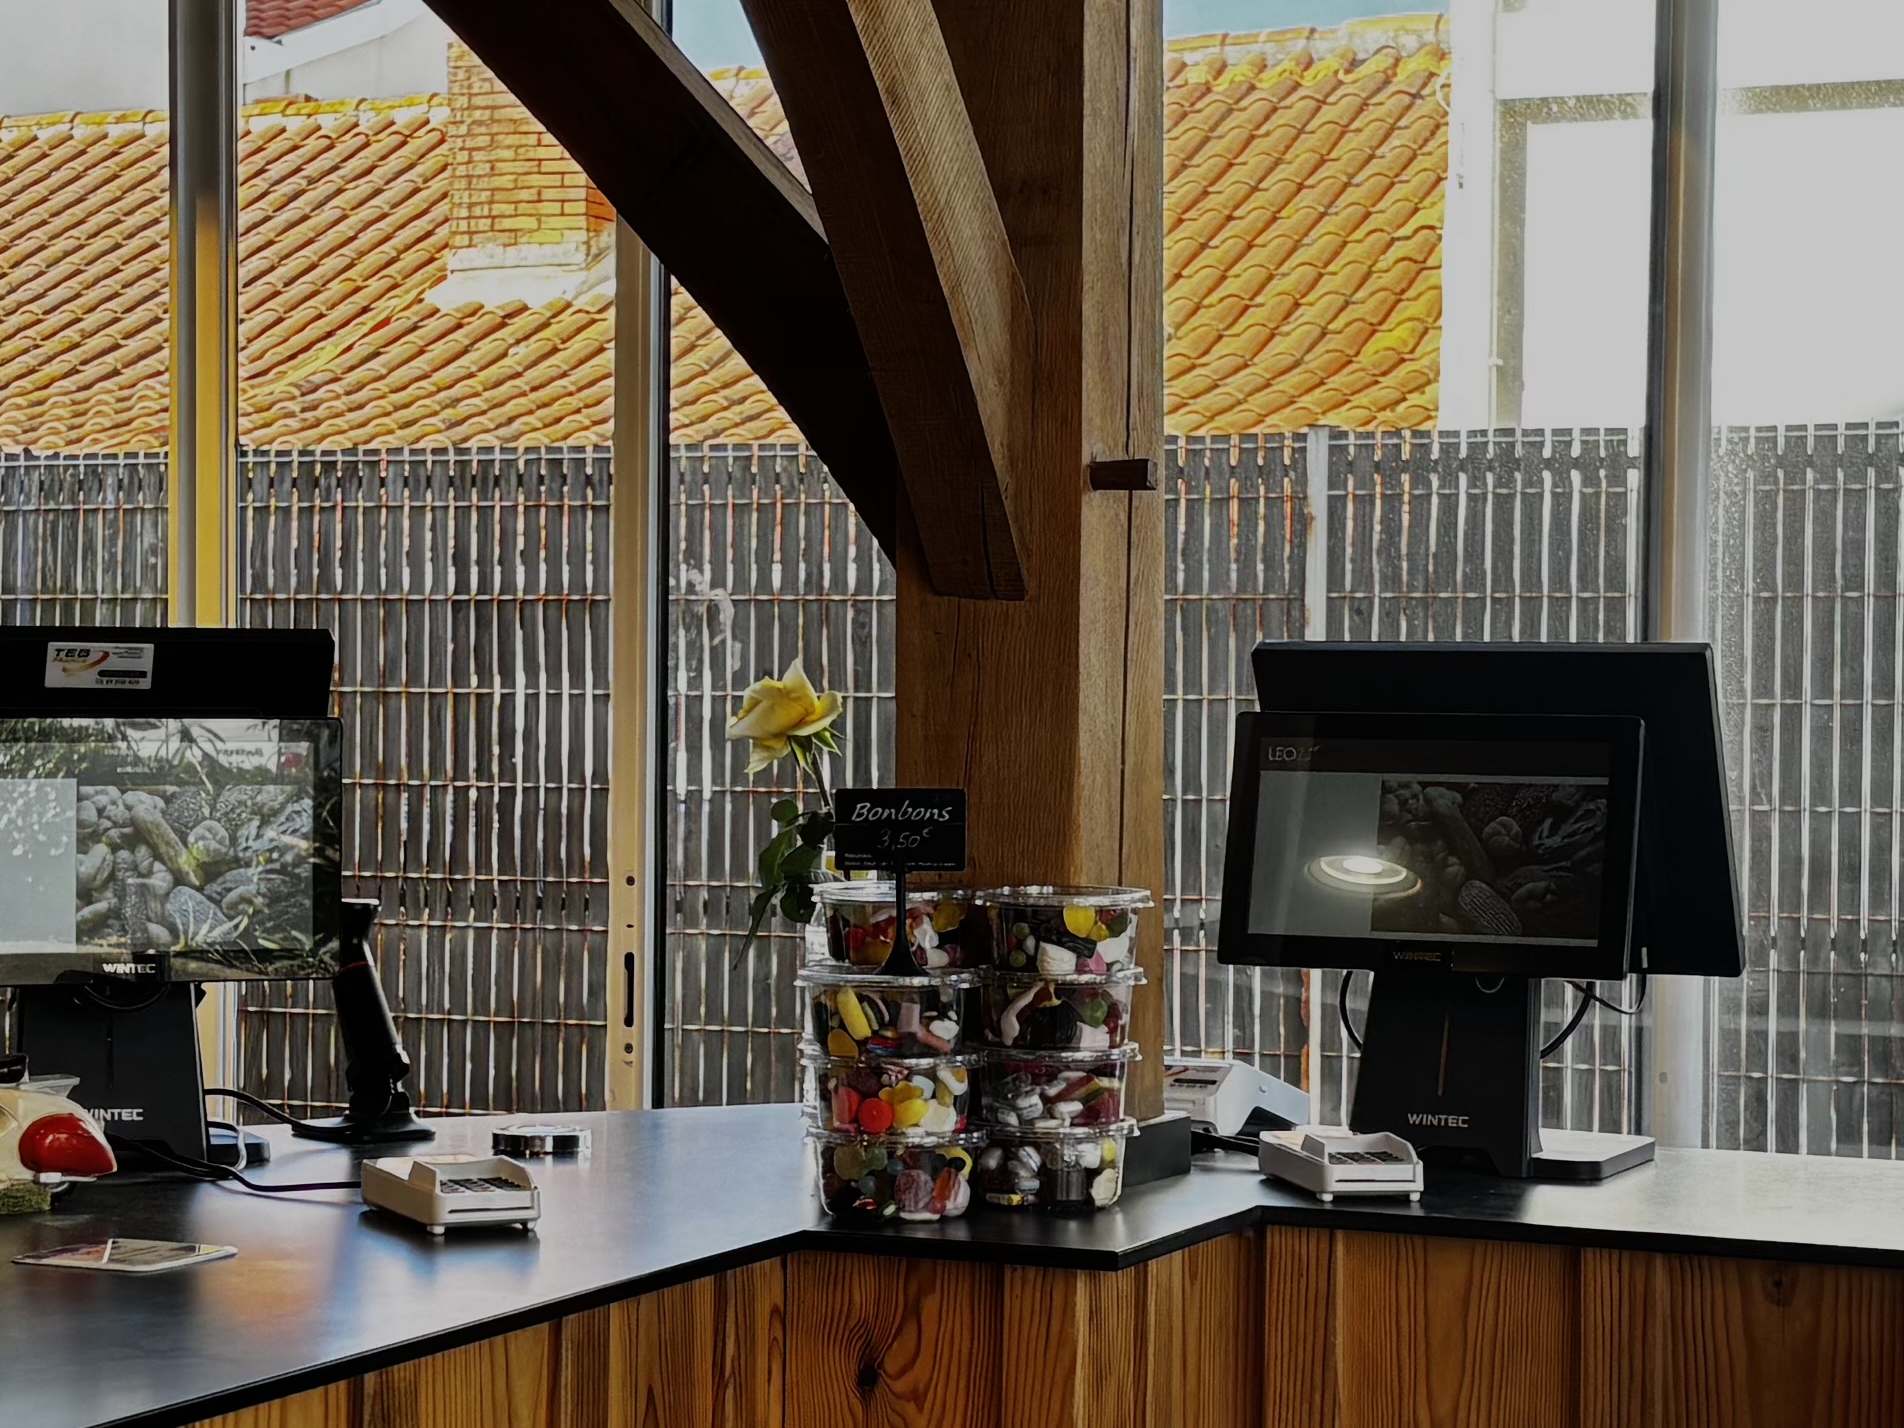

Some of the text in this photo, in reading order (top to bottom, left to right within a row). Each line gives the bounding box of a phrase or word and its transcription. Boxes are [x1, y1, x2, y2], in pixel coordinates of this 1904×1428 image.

[851, 800, 953, 822] Bonbons
[102, 962, 156, 974] WINTEC
[1407, 1113, 1470, 1128] WINTEC
